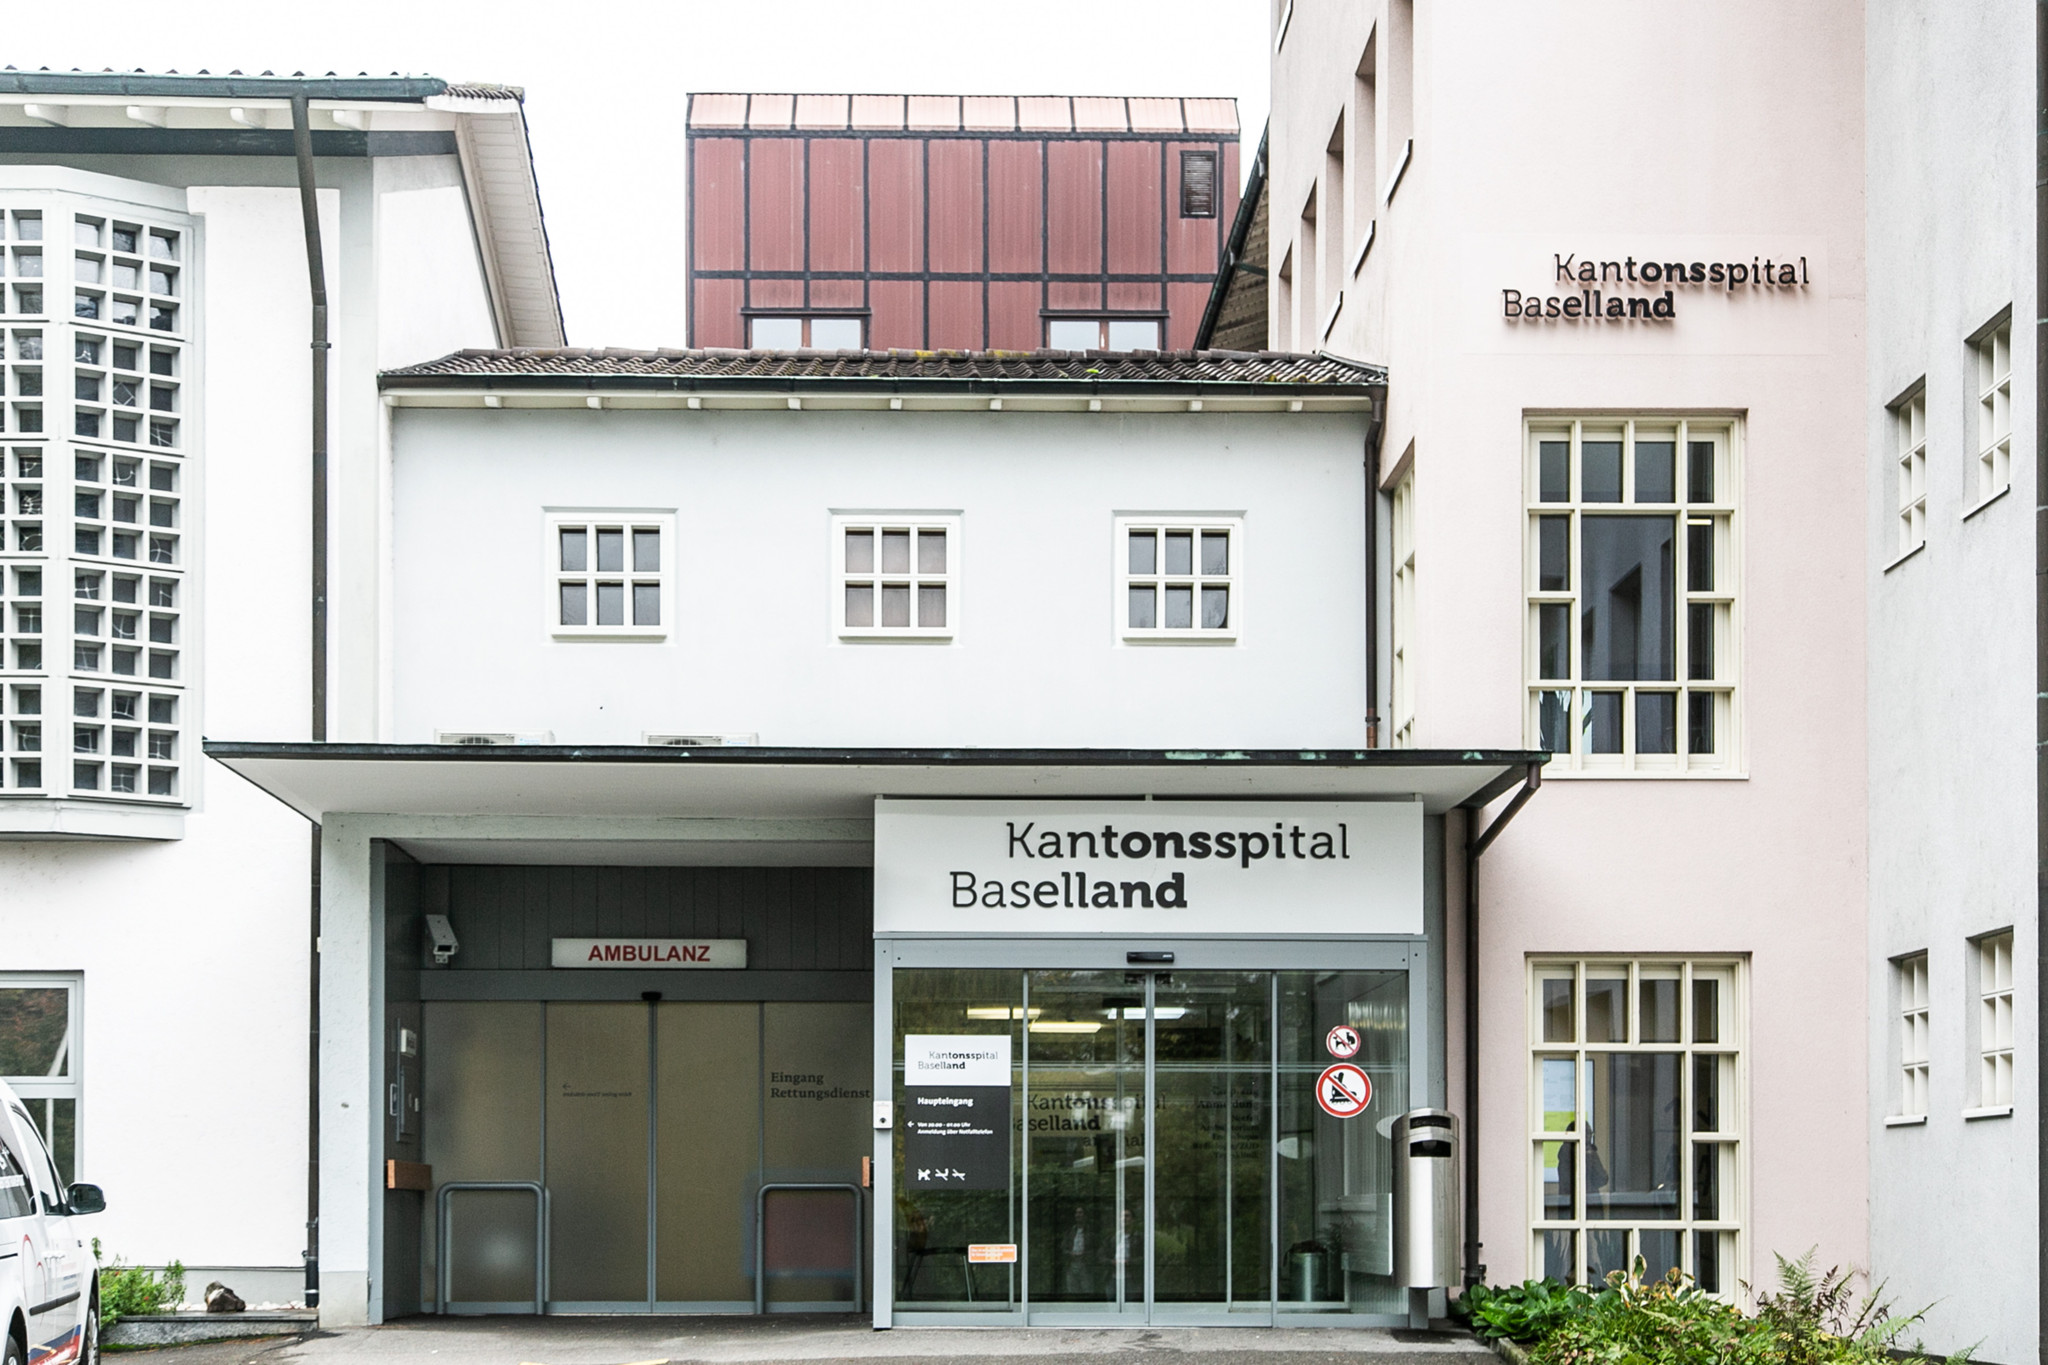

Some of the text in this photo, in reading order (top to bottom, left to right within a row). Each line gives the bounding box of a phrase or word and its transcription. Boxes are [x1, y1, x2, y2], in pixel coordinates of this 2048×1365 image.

[1555, 253, 1810, 291] Kantonsspital
[1502, 289, 1676, 319] Baselland
[1006, 822, 1350, 868] Kantonsspital
[949, 871, 1188, 909] Baselland
[588, 945, 711, 962] AMBULANZ
[929, 1050, 998, 1061] Kantonsspital
[918, 1061, 966, 1070] Baselland
[771, 1072, 824, 1086] Eingang
[770, 1087, 871, 1101] Rettungsdienst
[917, 1097, 974, 1107] Haupteingang
[1012, 1115, 1101, 1132] aselland
